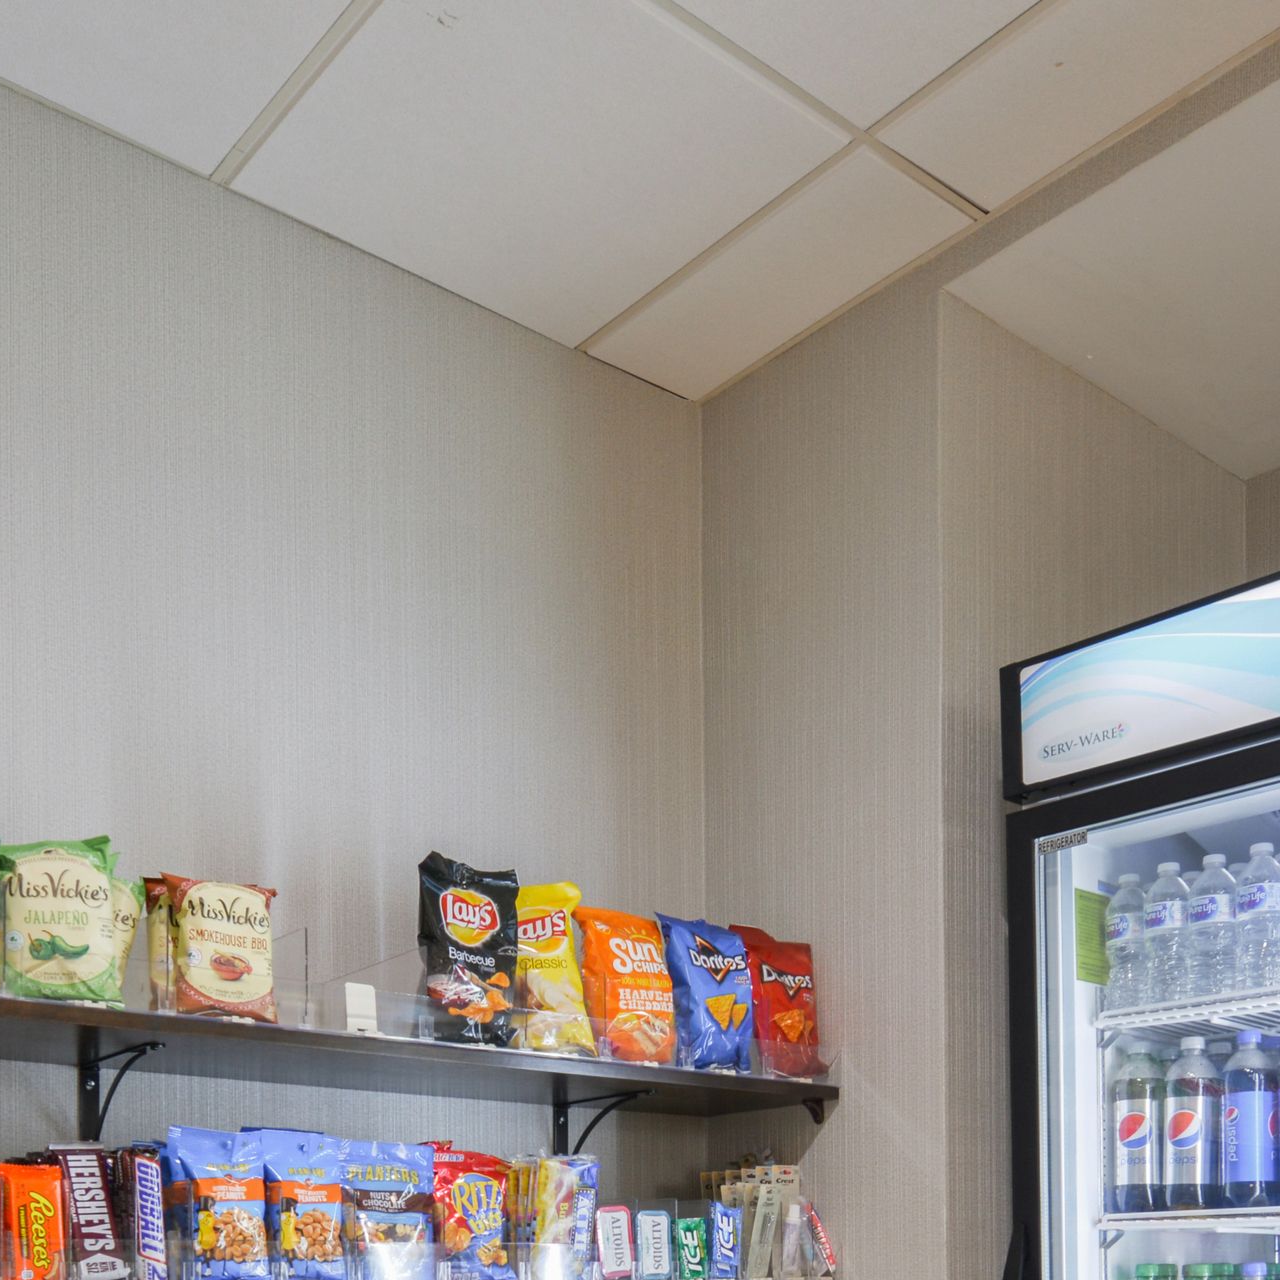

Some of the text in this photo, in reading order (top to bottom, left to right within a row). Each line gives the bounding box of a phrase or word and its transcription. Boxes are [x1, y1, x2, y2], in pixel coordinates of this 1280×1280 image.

[1042, 726, 1118, 760] SERV-WARE
[1038, 831, 1087, 853] REFRIGERATOR
[445, 894, 494, 929] Lay's
[1203, 902, 1218, 913] Life
[1251, 891, 1265, 901] Life
[24, 909, 89, 926] JALAPEÑO
[188, 928, 269, 951] SMOKEHOUSE BBQ
[608, 938, 663, 975] Sun
[448, 947, 496, 968] Barbecue
[521, 957, 568, 970] Classic
[690, 949, 747, 971] Doritos
[1228, 1126, 1239, 1162] pepsi
[66, 1154, 116, 1251] HERSHEY'S
[453, 1180, 501, 1218] RITZ
[28, 1191, 55, 1269] Reese's
[610, 1216, 625, 1268] ALTOIDS
[651, 1219, 663, 1271] ALTOIDS
[718, 1213, 734, 1258] ICE
[681, 1230, 702, 1271] ICE
